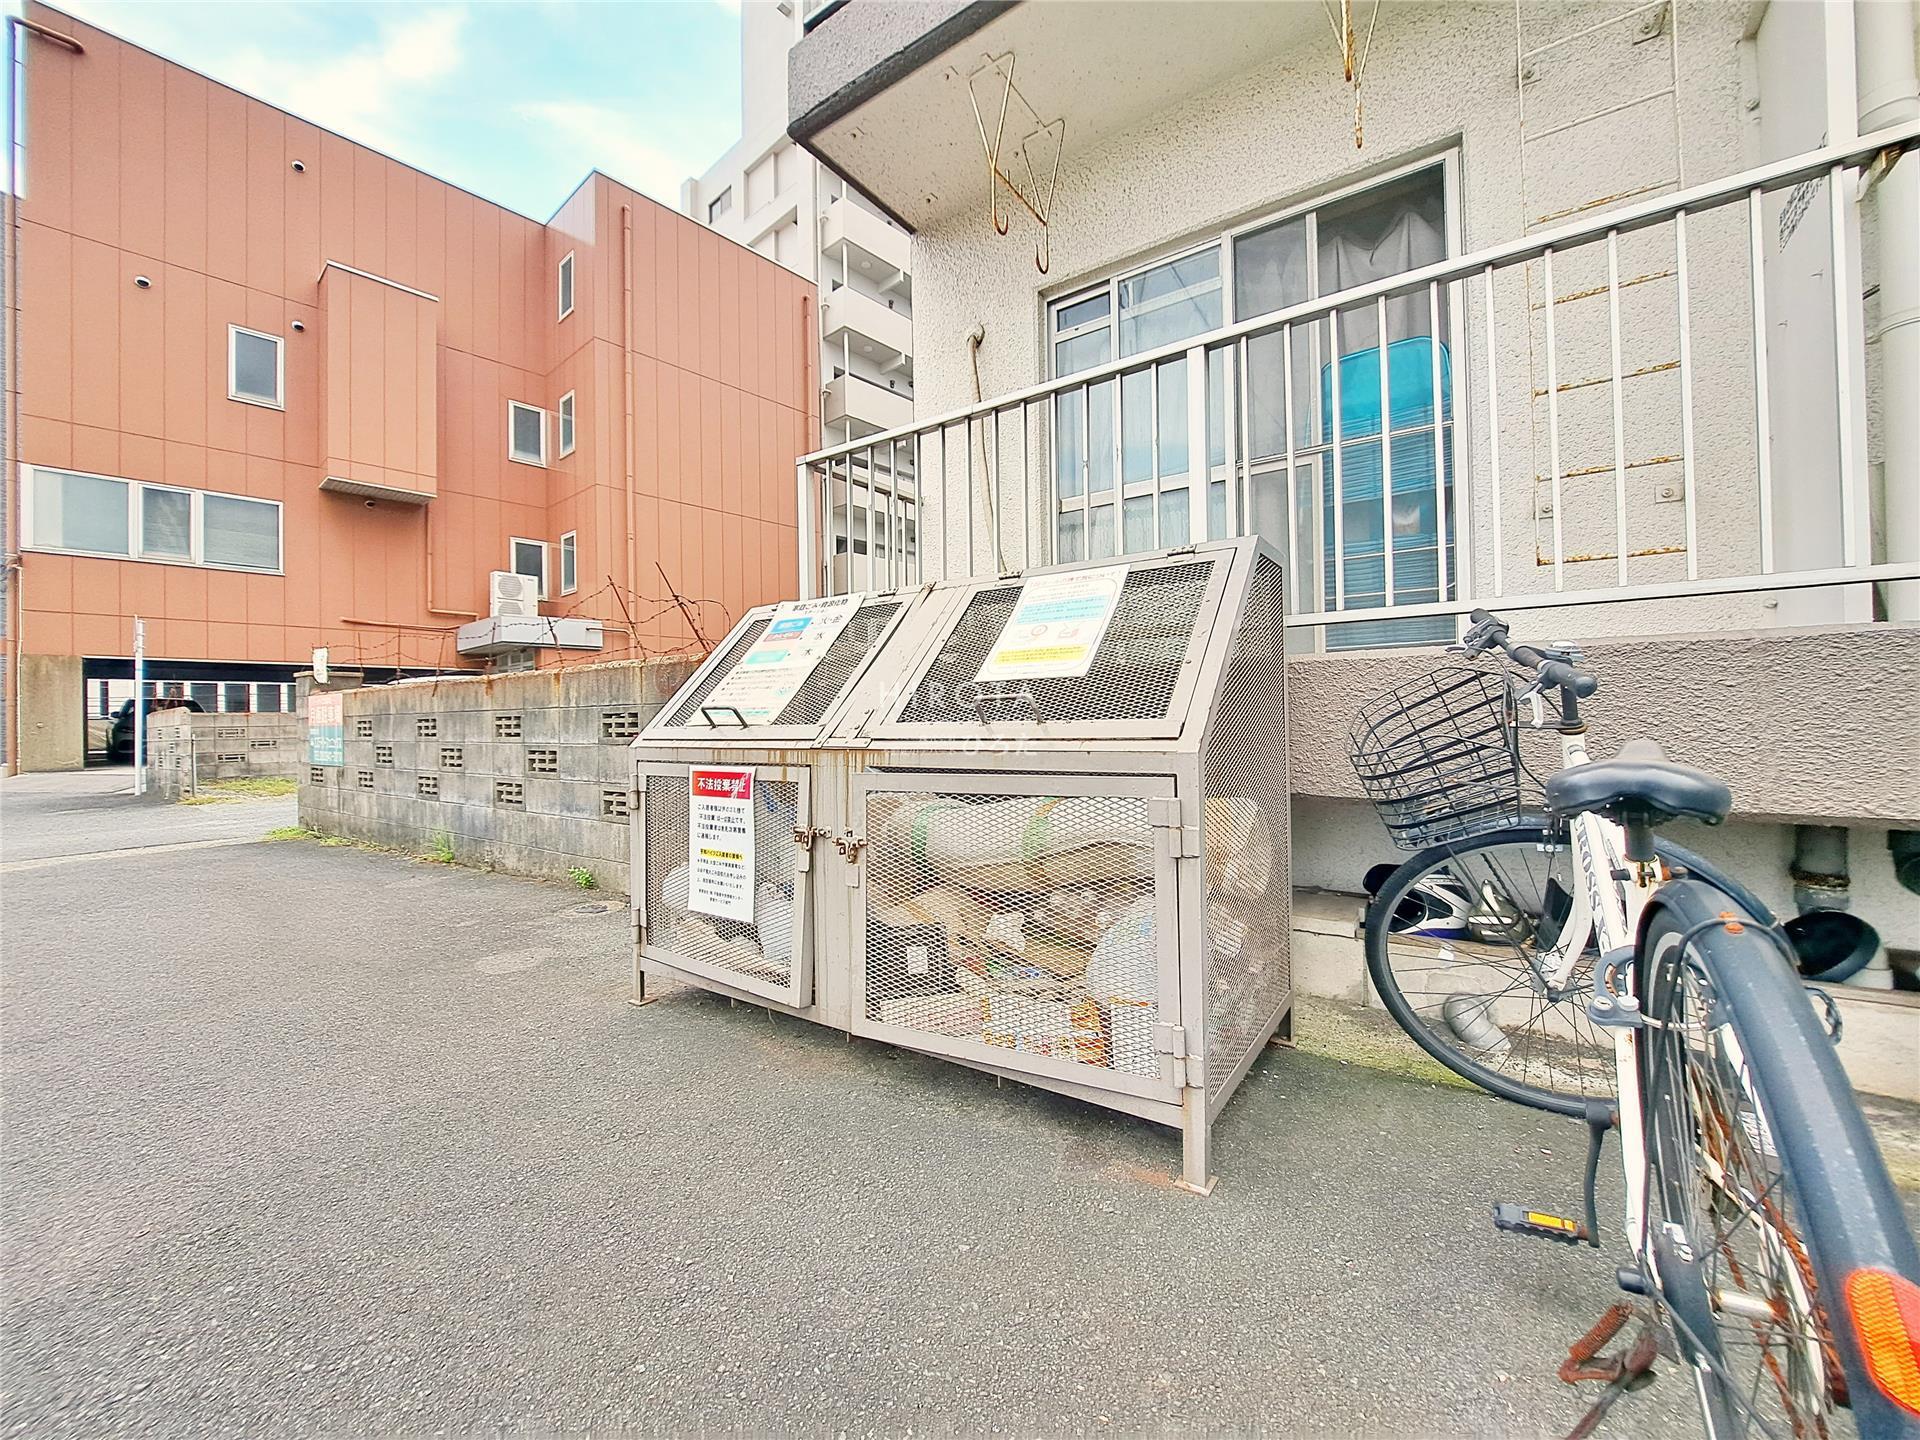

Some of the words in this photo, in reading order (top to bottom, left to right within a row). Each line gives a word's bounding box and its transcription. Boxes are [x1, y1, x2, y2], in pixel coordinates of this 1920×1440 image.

[697, 777, 746, 793] 不法投棄禁止
